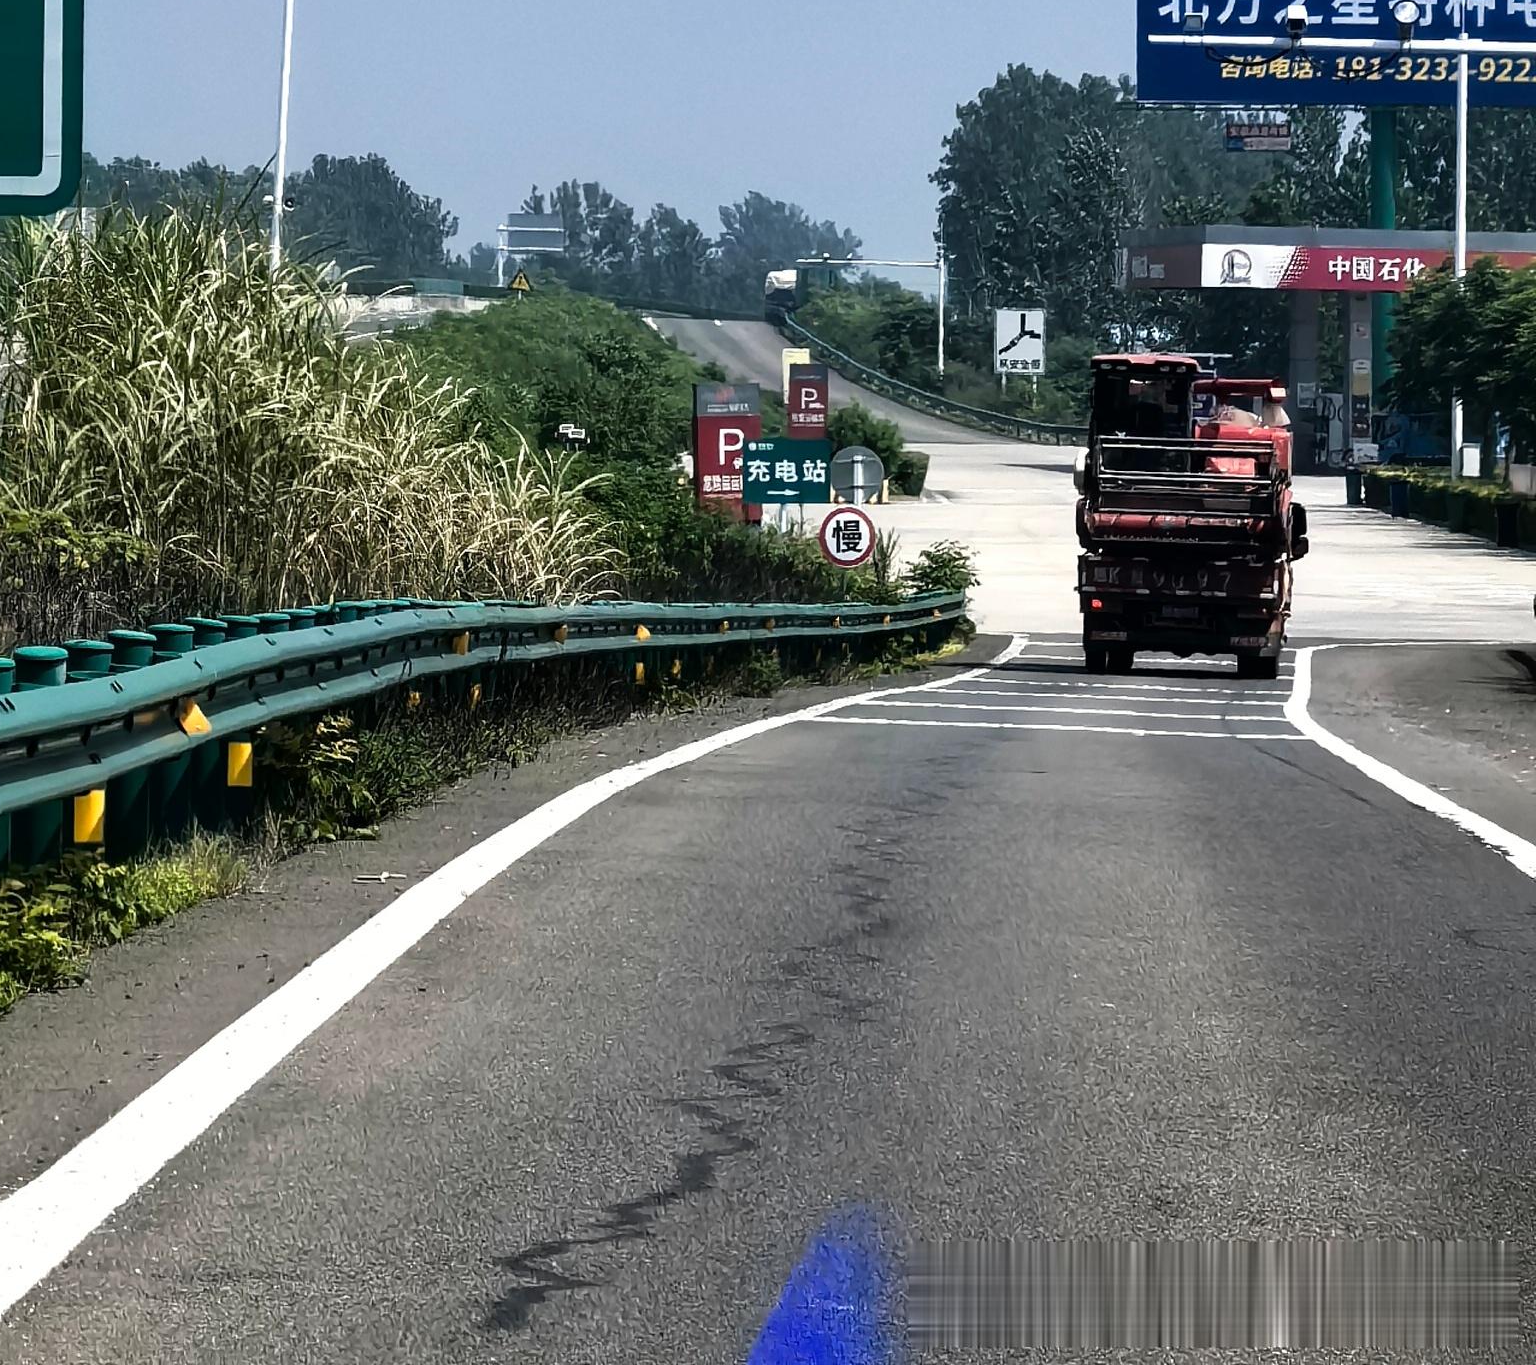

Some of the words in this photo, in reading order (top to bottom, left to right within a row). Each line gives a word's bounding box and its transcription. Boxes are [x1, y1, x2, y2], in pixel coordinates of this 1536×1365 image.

[747, 459, 827, 484] 充电站
[831, 519, 863, 554] 慢
